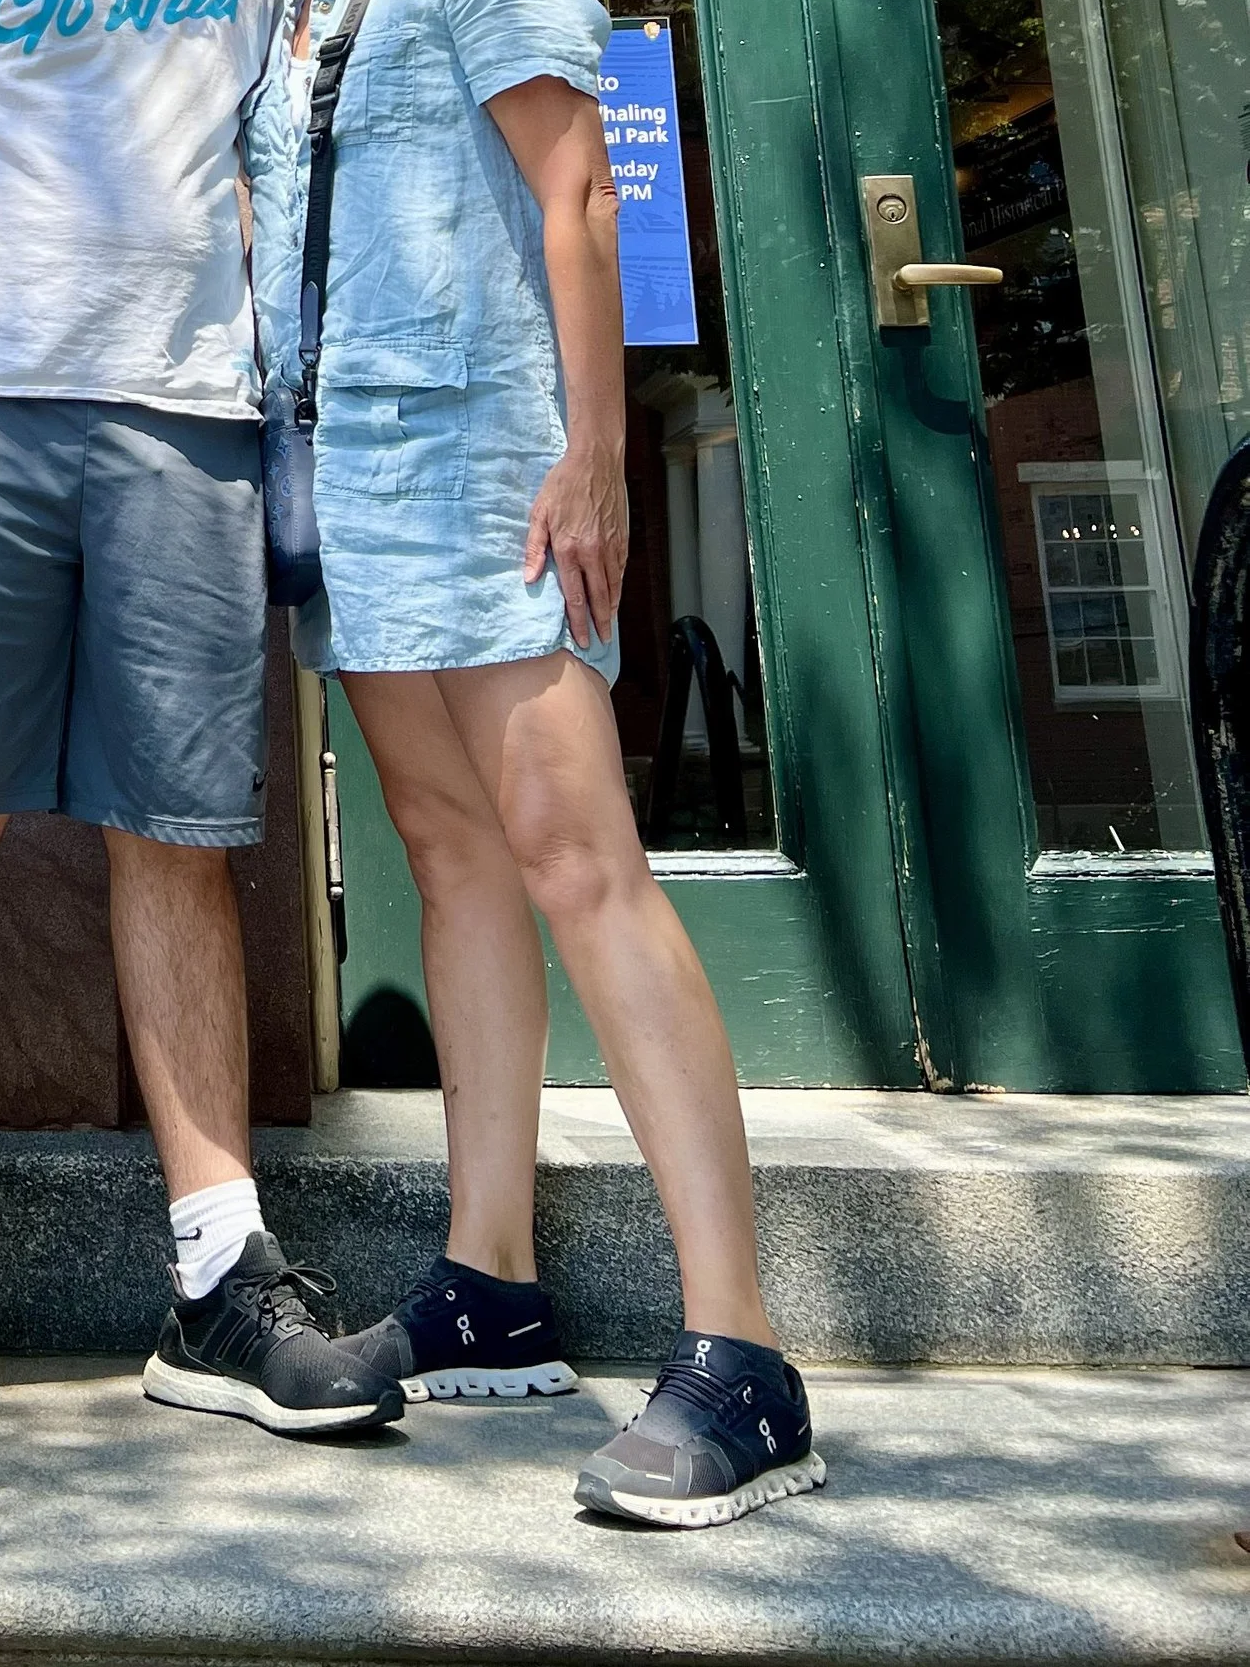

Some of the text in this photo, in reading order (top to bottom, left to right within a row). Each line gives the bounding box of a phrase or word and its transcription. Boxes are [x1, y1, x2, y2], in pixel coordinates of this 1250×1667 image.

[625, 125, 670, 143] Park
[611, 159, 659, 181] nday
[621, 183, 653, 201] PM
